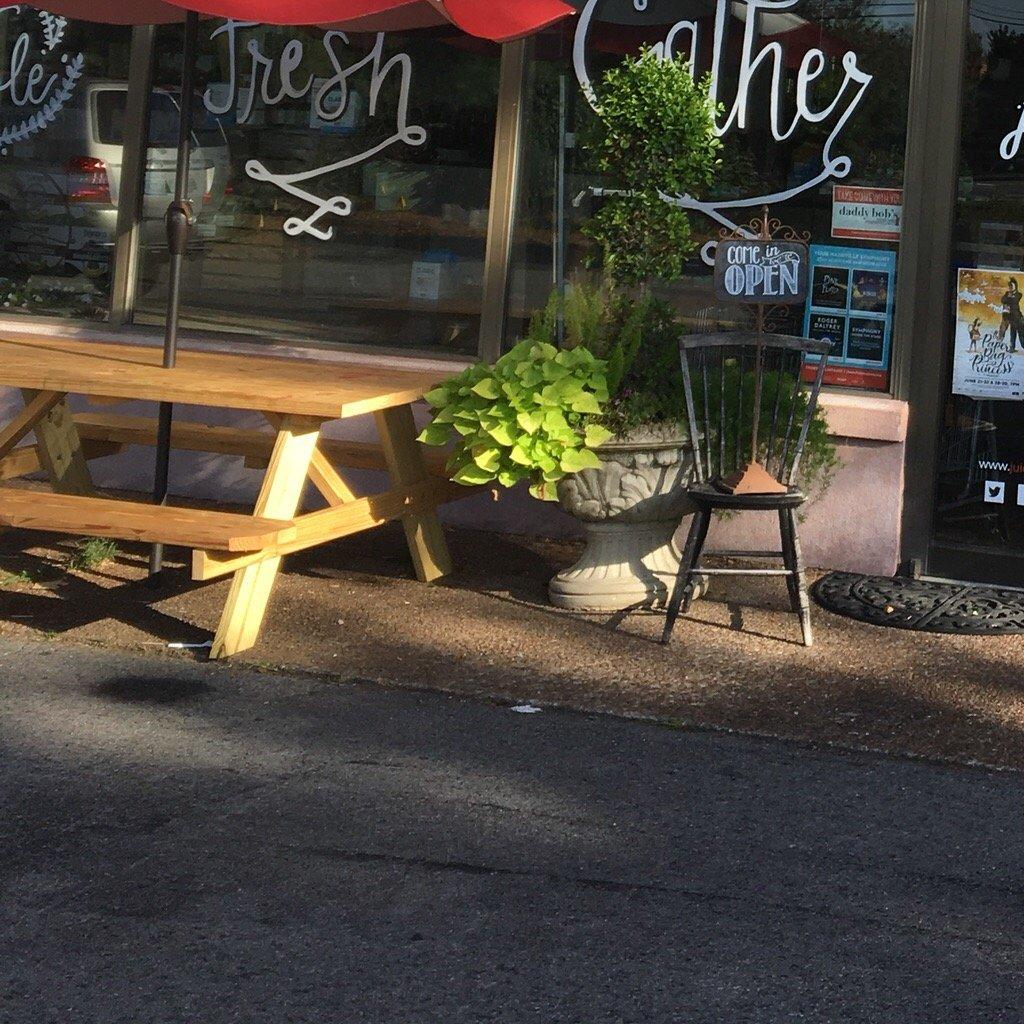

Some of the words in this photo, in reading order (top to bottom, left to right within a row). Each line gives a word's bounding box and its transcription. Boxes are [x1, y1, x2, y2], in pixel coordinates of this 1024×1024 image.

[0, 32, 58, 106] le
[838, 205, 870, 222] daddy
[765, 245, 780, 257] in
[724, 260, 800, 296] OPEN
